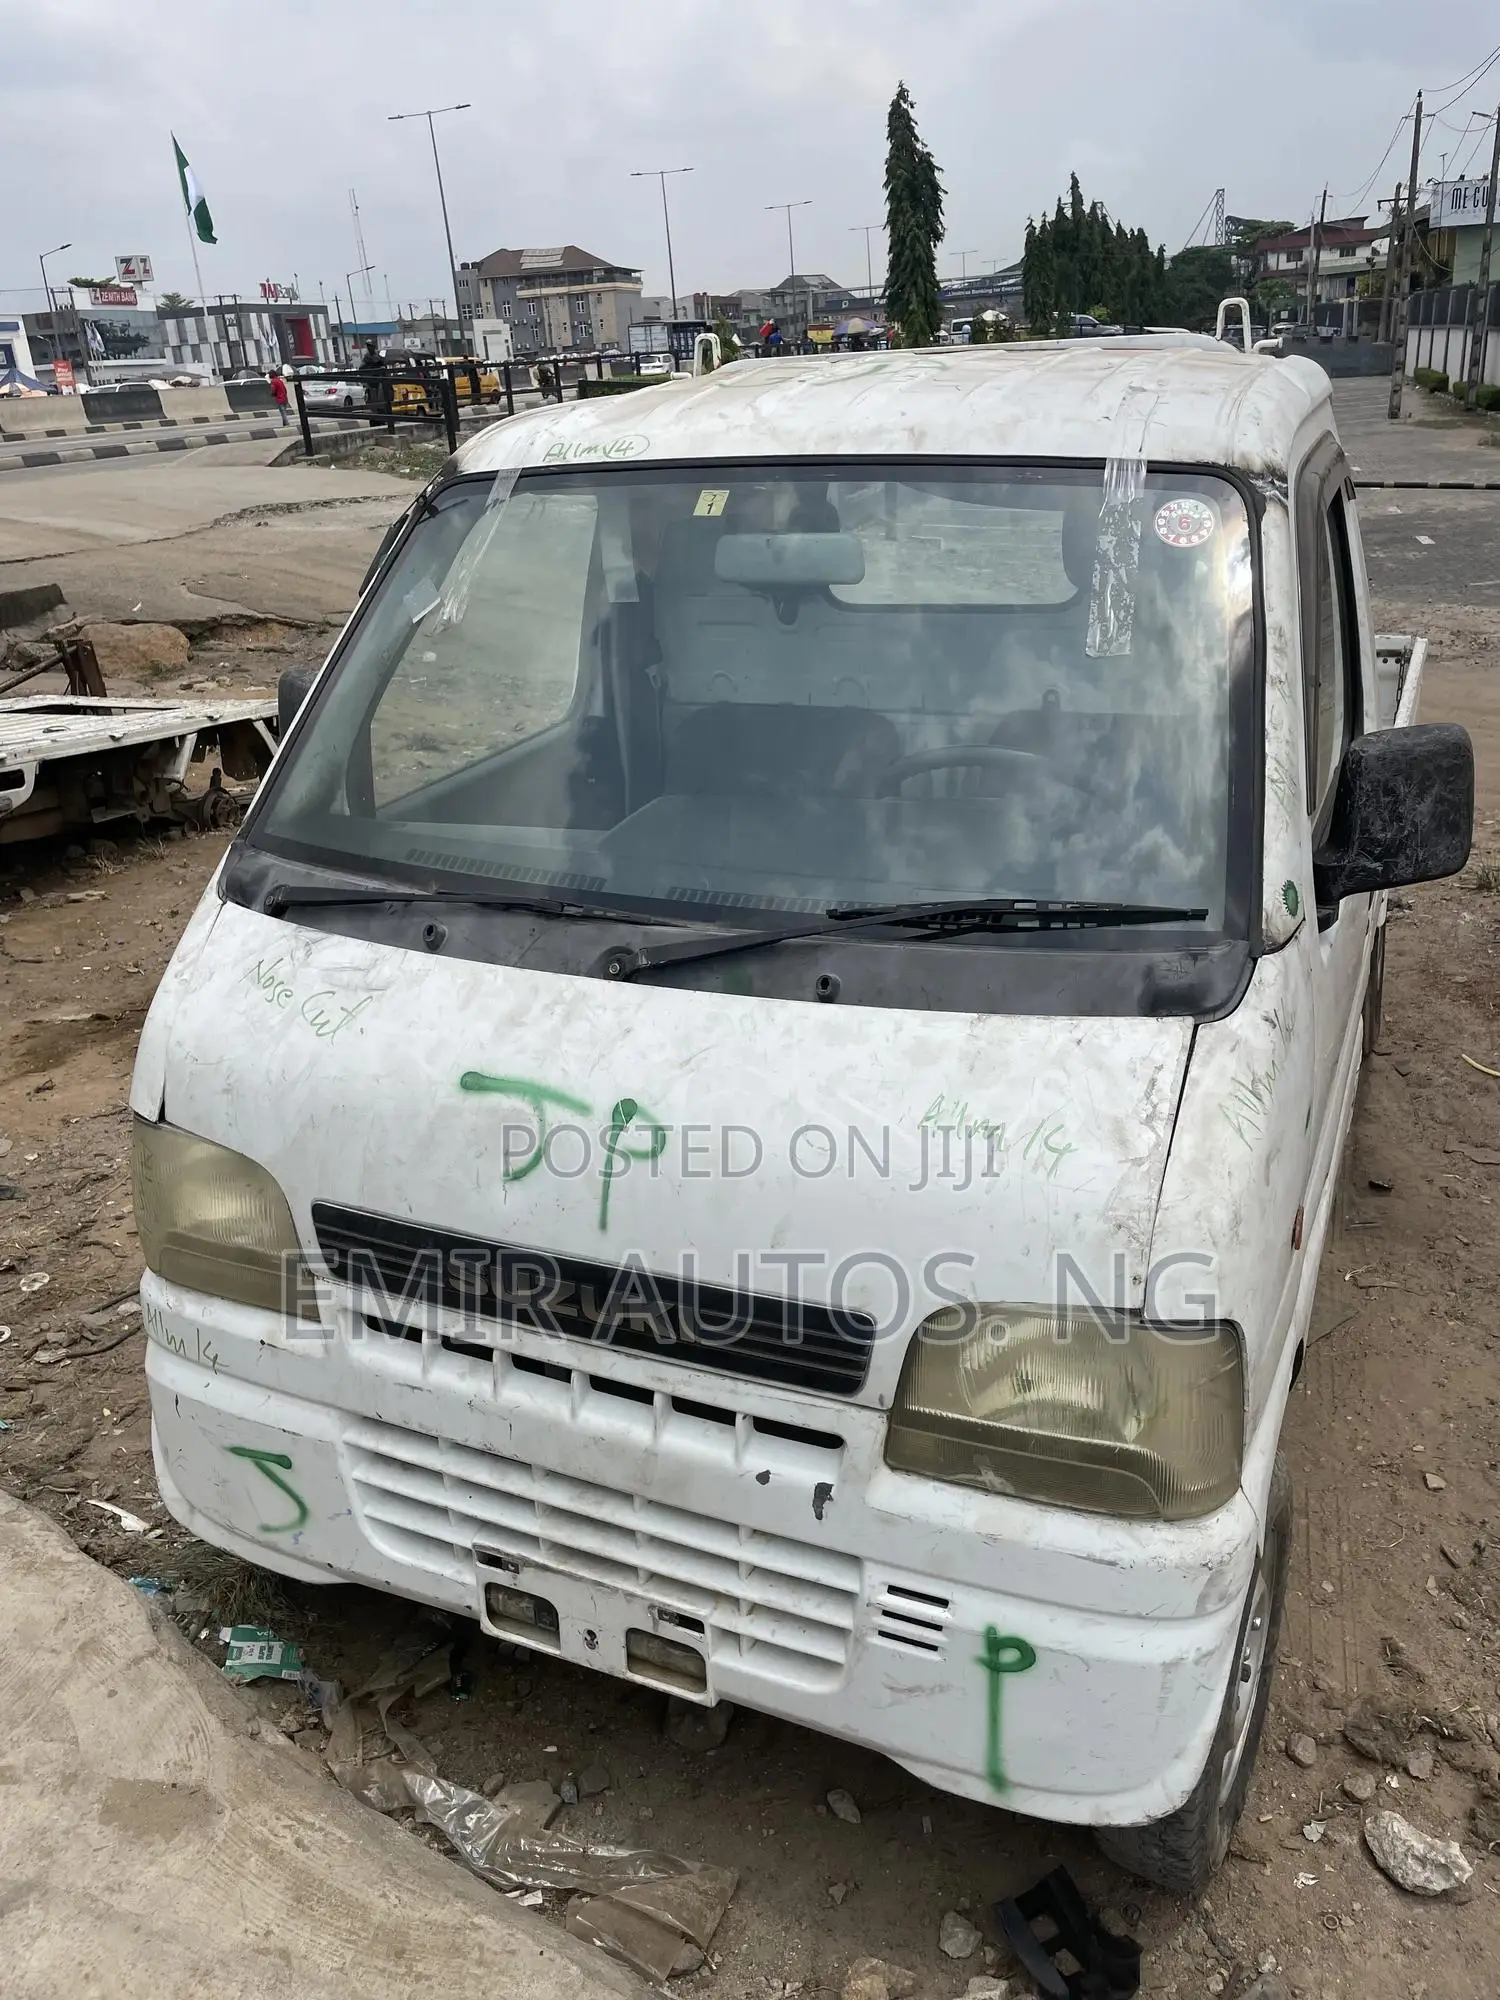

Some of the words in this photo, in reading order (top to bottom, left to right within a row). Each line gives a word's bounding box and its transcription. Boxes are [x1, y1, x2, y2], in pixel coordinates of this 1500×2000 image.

[1451, 187, 1469, 209] ME
[101, 292, 120, 302] ZENITH
[707, 502, 714, 515] 1
[447, 1258, 696, 1343] SUZUKI
[974, 1624, 1037, 1794] P
